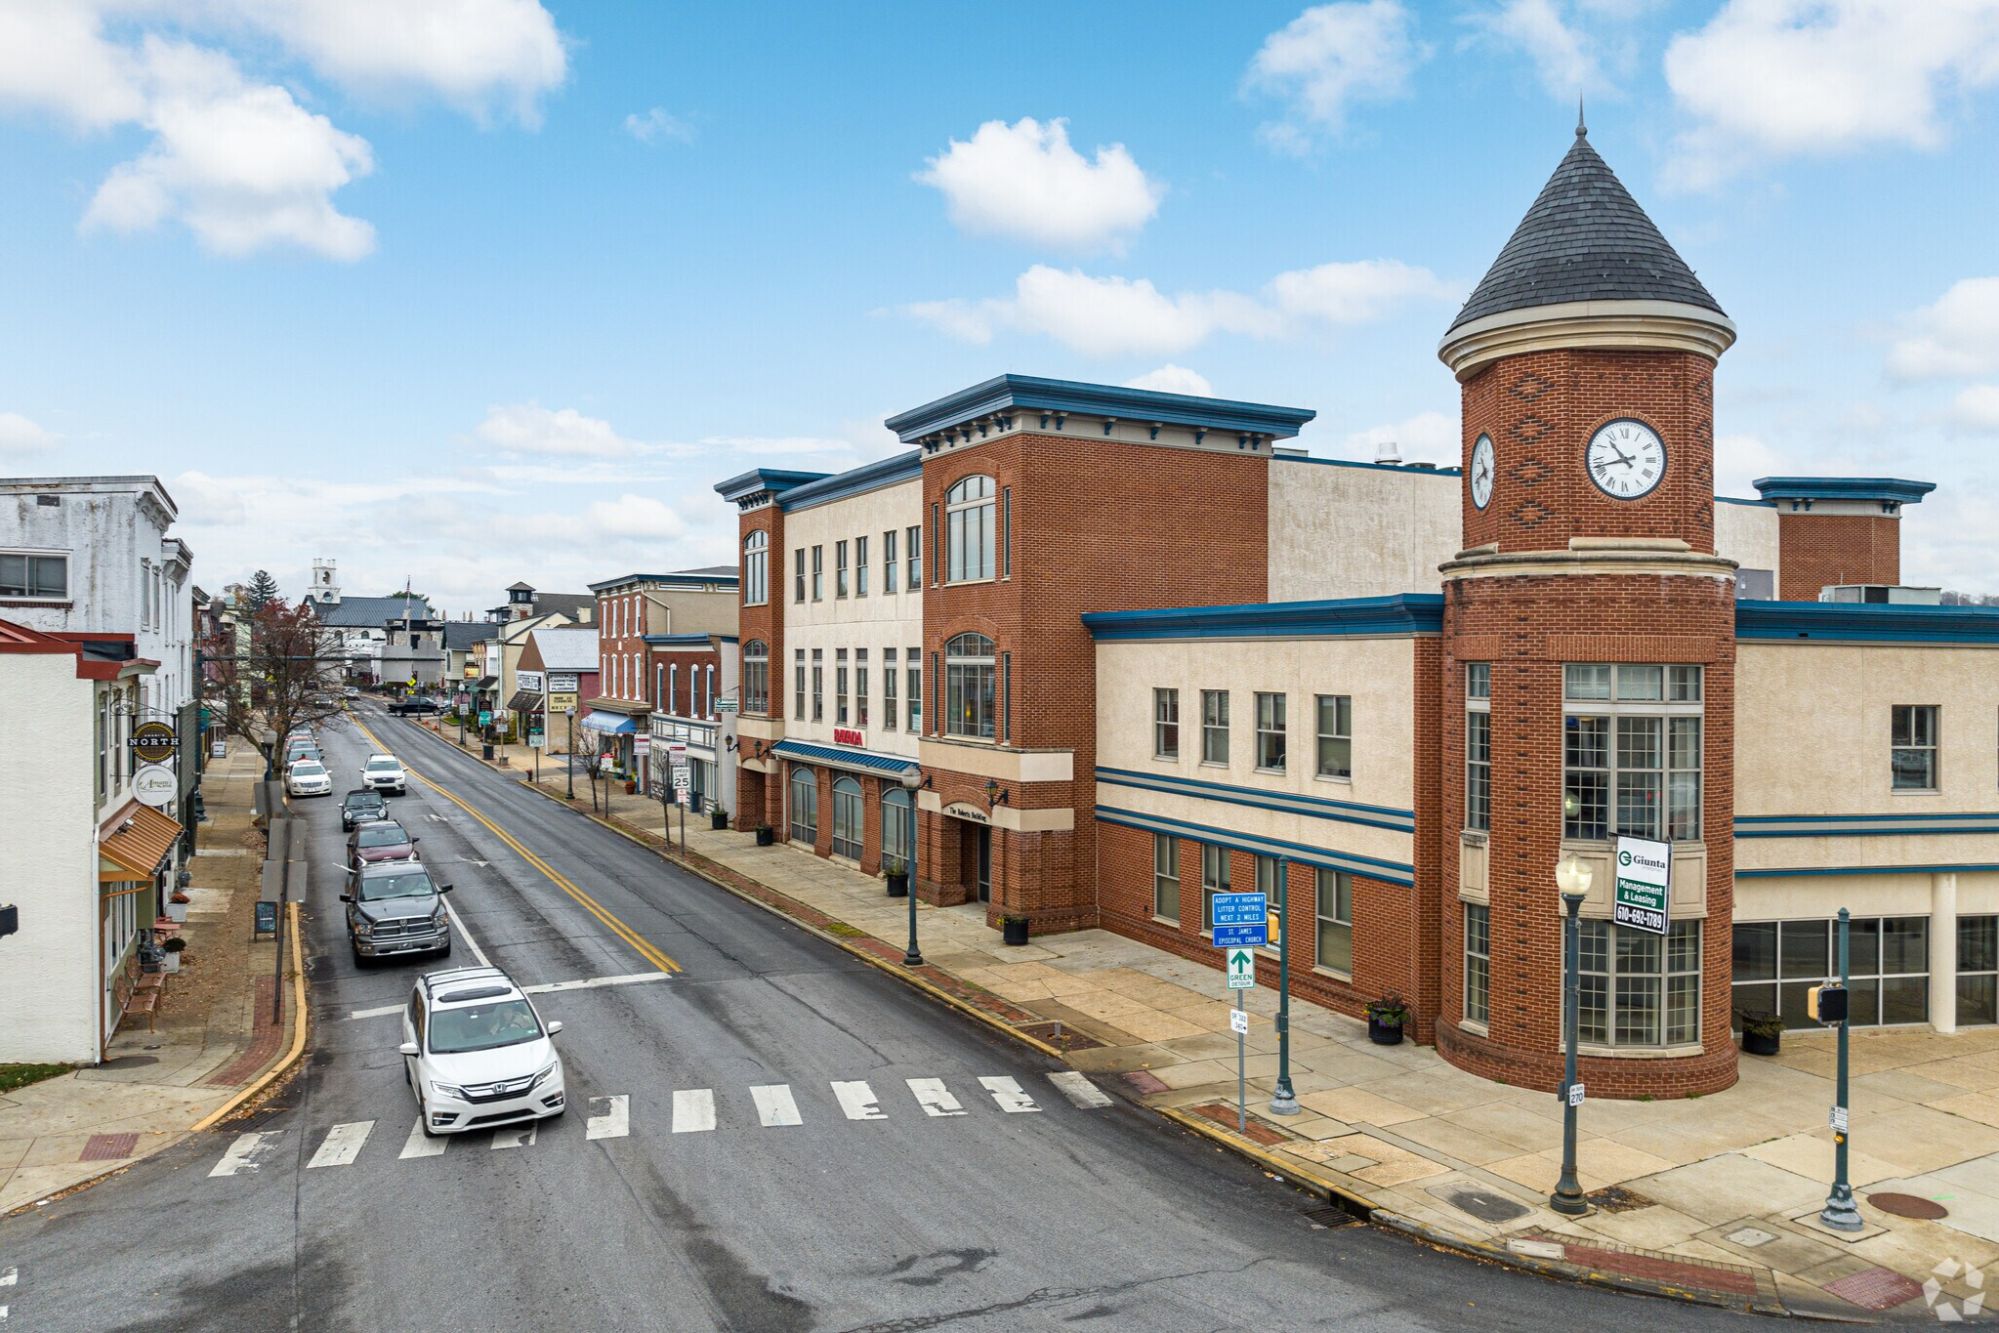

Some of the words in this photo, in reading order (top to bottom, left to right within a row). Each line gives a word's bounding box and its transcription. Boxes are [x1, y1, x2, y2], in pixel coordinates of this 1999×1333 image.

[129, 738, 180, 746] NORTH
[674, 777, 689, 787] 25
[949, 806, 957, 815] The
[971, 811, 987, 822] Building
[1633, 854, 1666, 869] Giunta
[1619, 880, 1663, 897] Management
[1624, 891, 1629, 900] &
[1630, 892, 1657, 907] Leasing
[1617, 906, 1662, 928] 610-692-1789
[1570, 1092, 1584, 1104] 270
